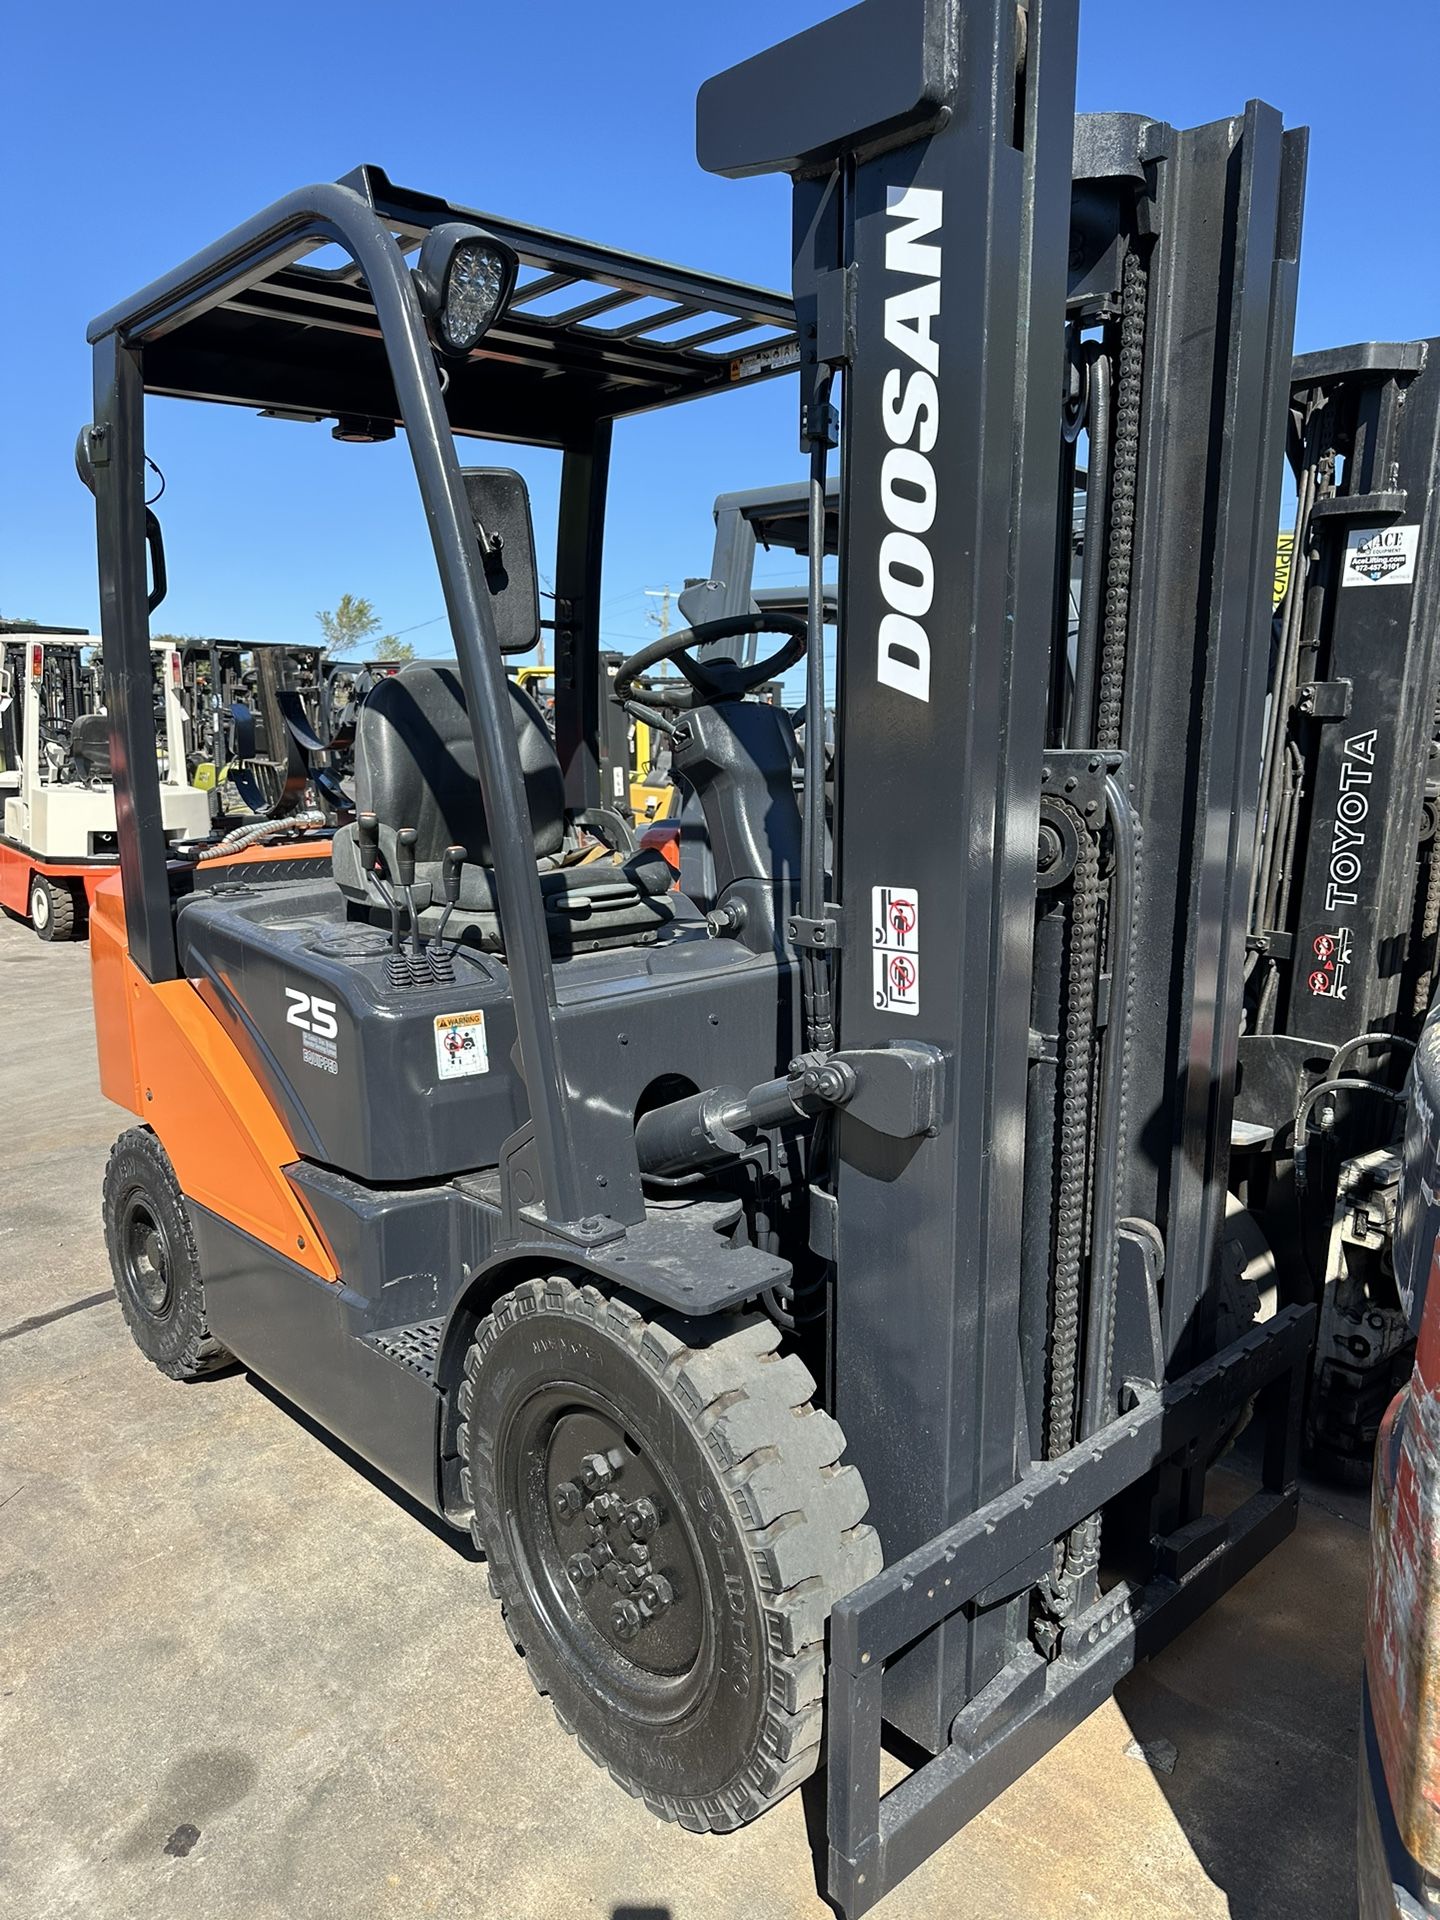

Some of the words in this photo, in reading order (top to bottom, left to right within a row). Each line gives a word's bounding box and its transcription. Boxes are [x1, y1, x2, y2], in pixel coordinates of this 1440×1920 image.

[877, 185, 943, 703] DOOSAN
[1373, 532, 1404, 548] ACE
[1351, 556, 1405, 565] AceLifting.com
[1325, 729, 1378, 911] TOYOTA
[285, 987, 338, 1039] 25
[447, 1015, 480, 1026] WARNING
[303, 1048, 338, 1075] EQUIPPED
